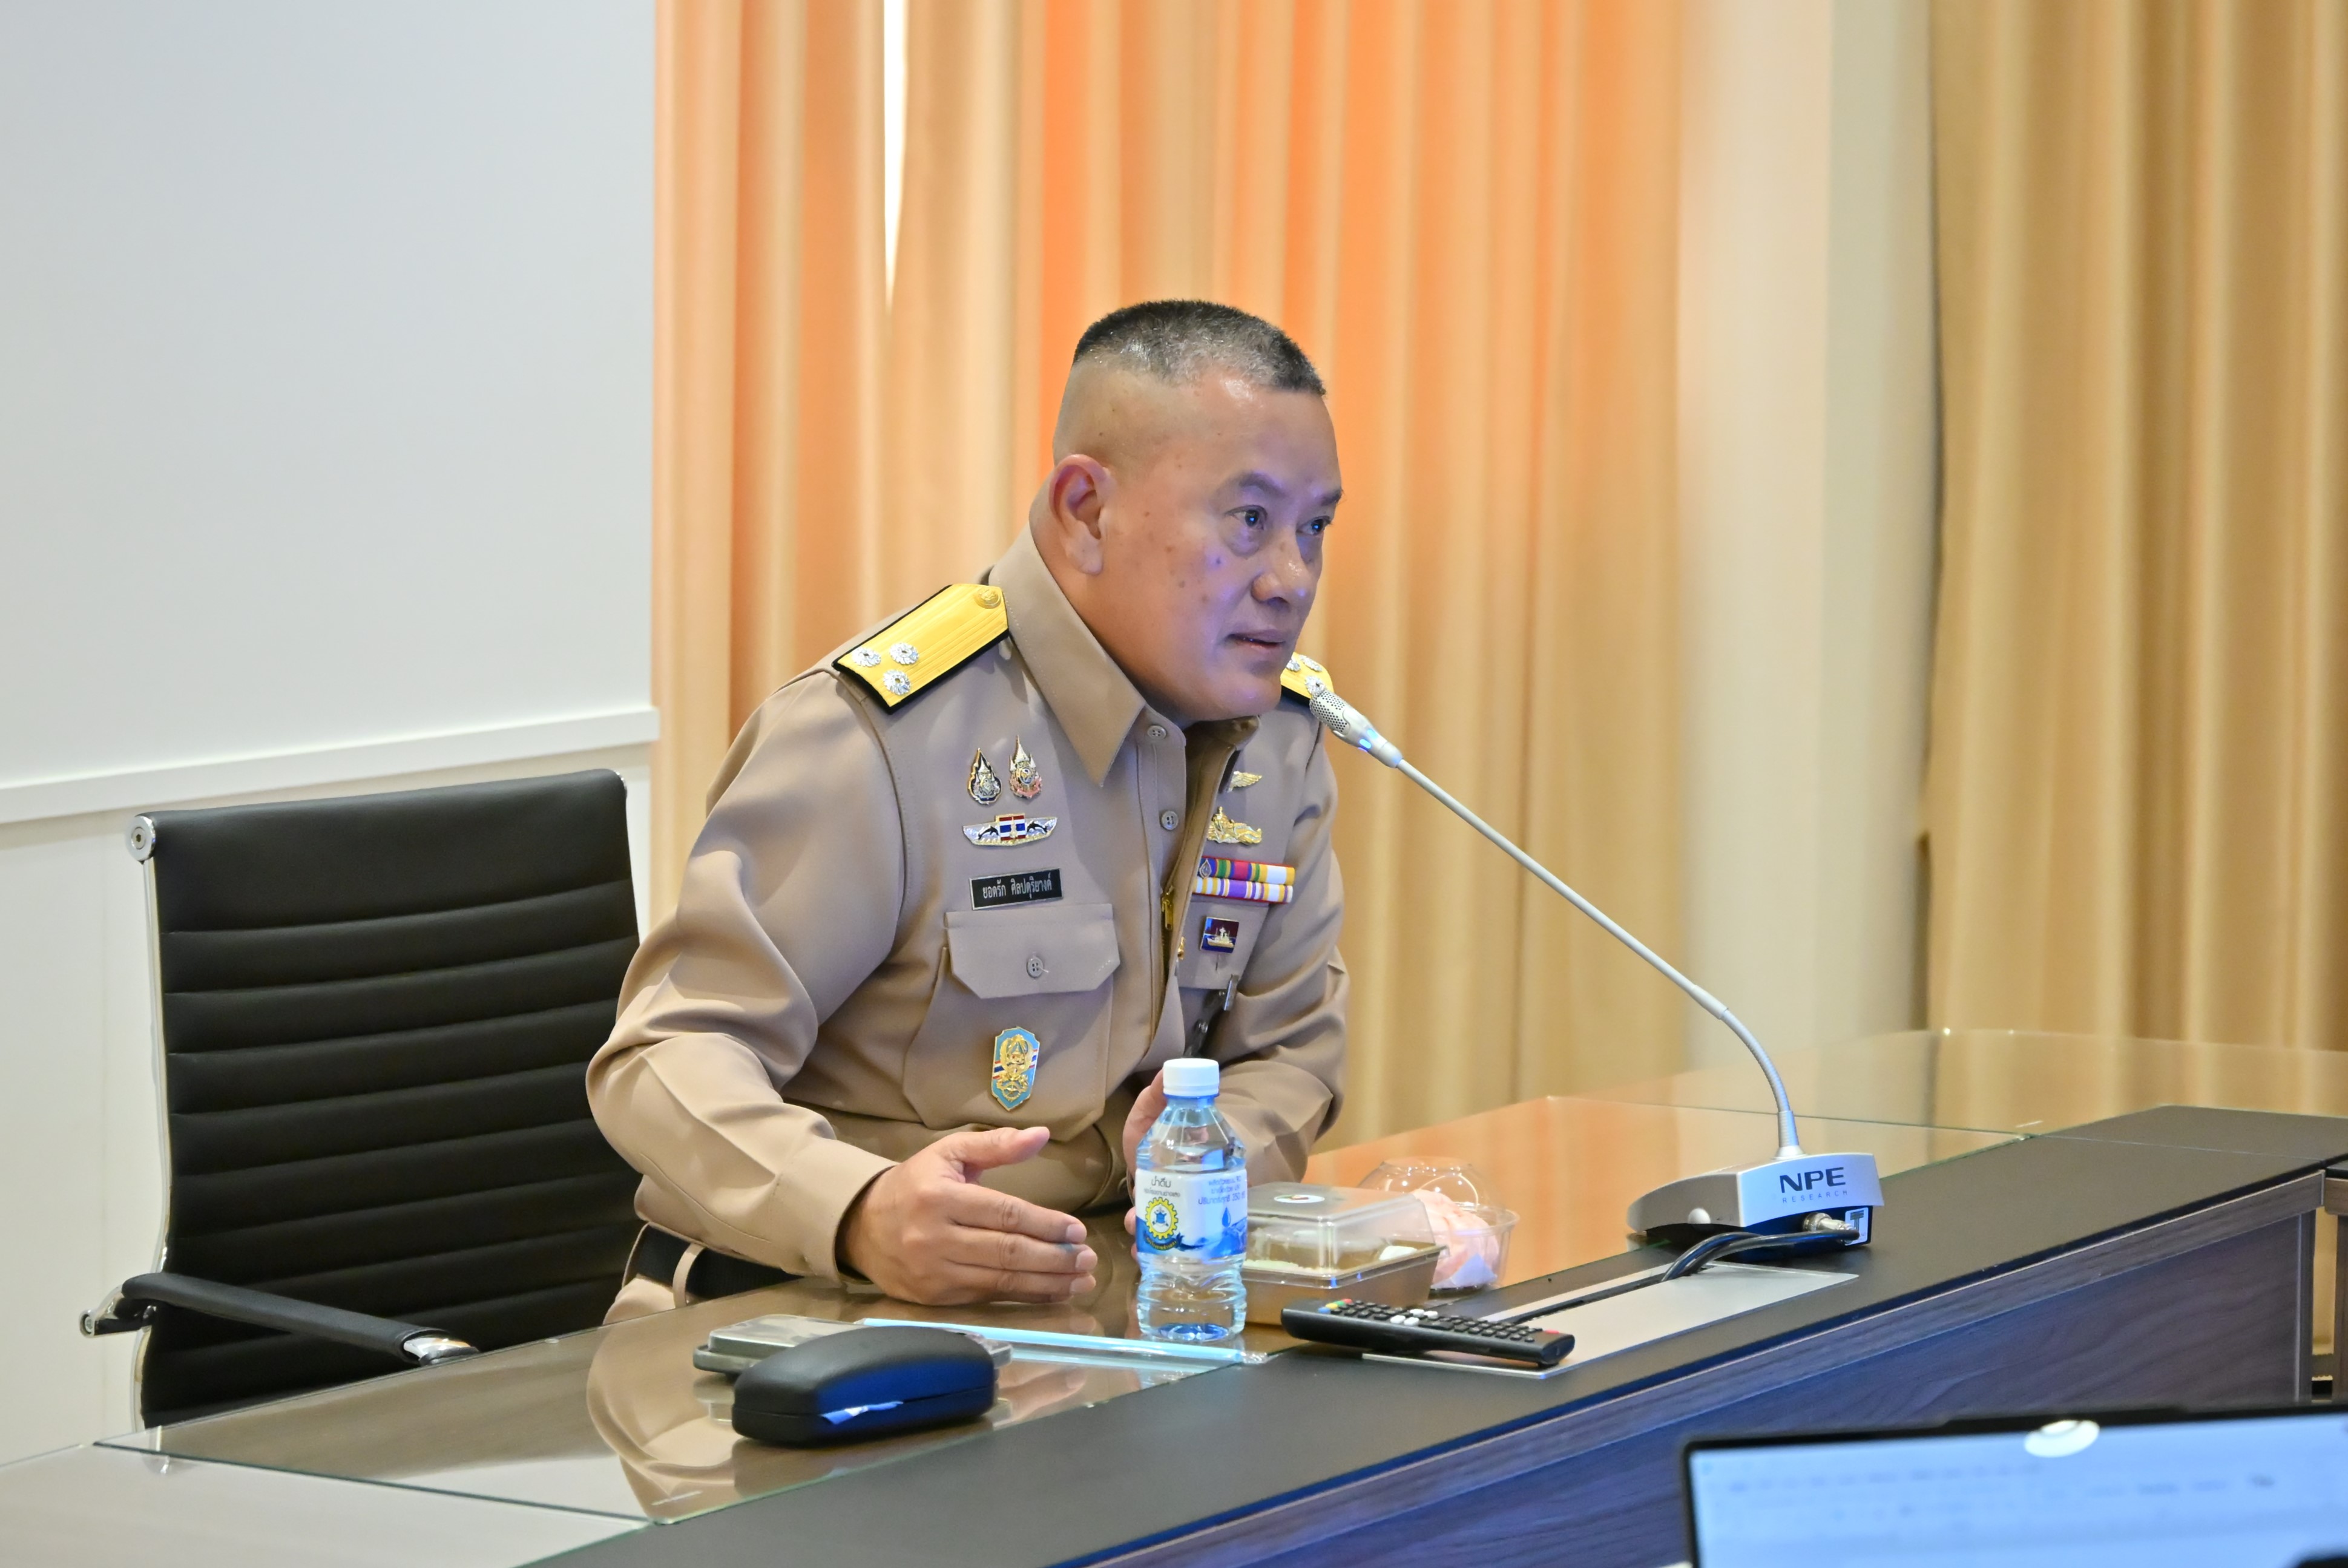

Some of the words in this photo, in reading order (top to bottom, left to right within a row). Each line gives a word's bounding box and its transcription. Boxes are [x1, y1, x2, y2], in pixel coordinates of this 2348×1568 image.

[982, 879, 1006, 899] ยอดรัก
[1780, 1167, 1846, 1193] NPE
[1782, 1190, 1847, 1203] RESEARCH
